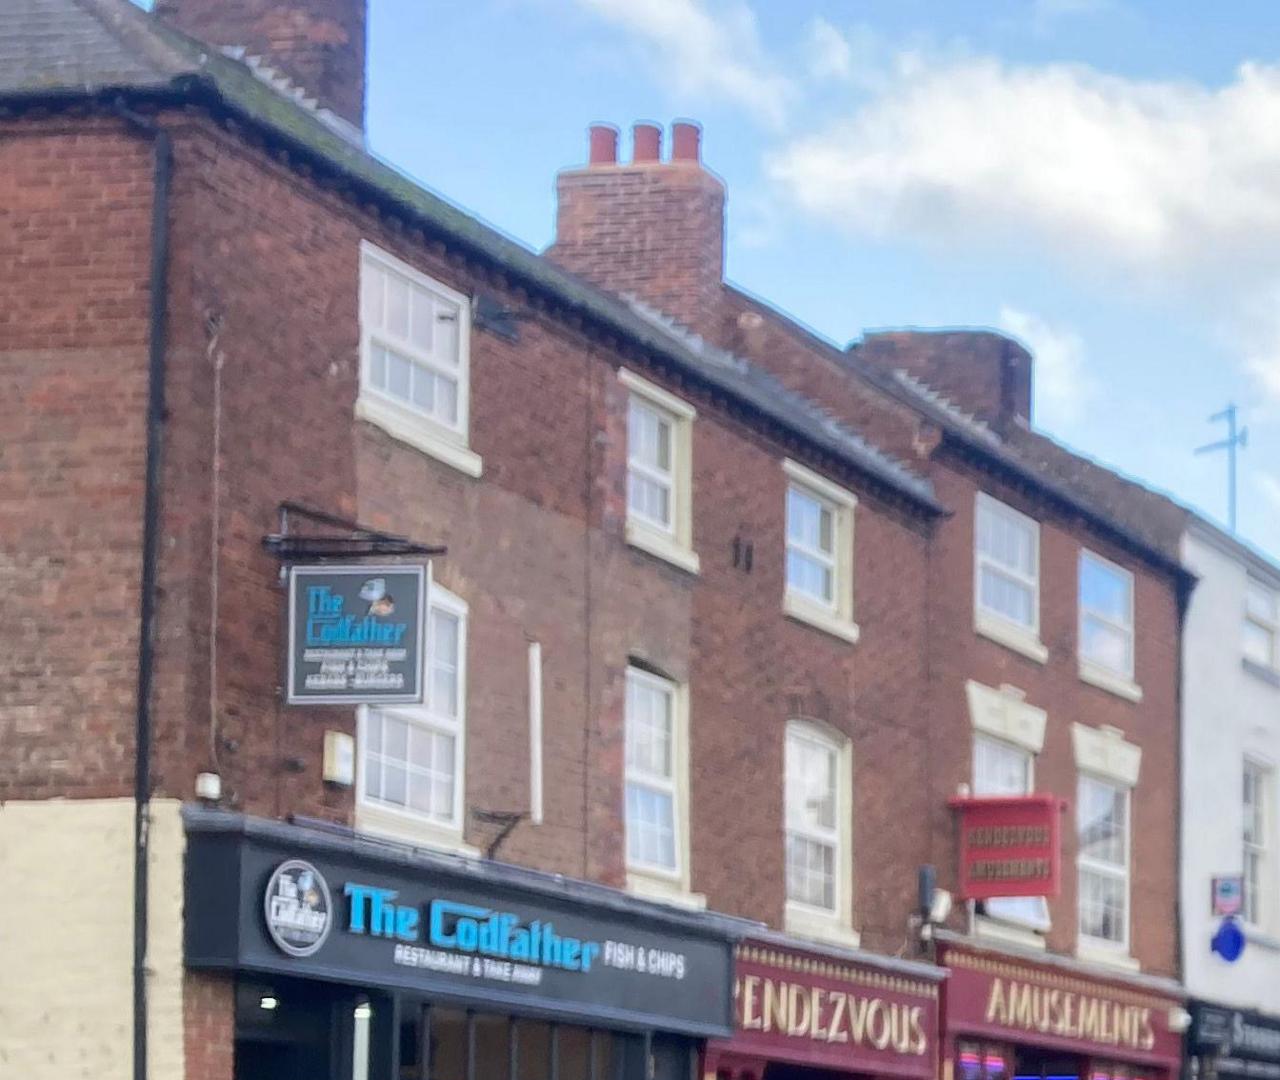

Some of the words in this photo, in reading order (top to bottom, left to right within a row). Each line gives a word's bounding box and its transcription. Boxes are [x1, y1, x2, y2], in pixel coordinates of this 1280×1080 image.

[306, 585, 344, 614] The
[344, 882, 418, 941] The
[430, 899, 600, 973] Codfather
[394, 943, 471, 976] RESTAURANT
[604, 939, 635, 969] FISH
[637, 947, 647, 970] &
[649, 948, 685, 980] CHIPS
[735, 974, 927, 1056] ENDEZVOUS
[986, 977, 1155, 1050] AMUSEMENTS
